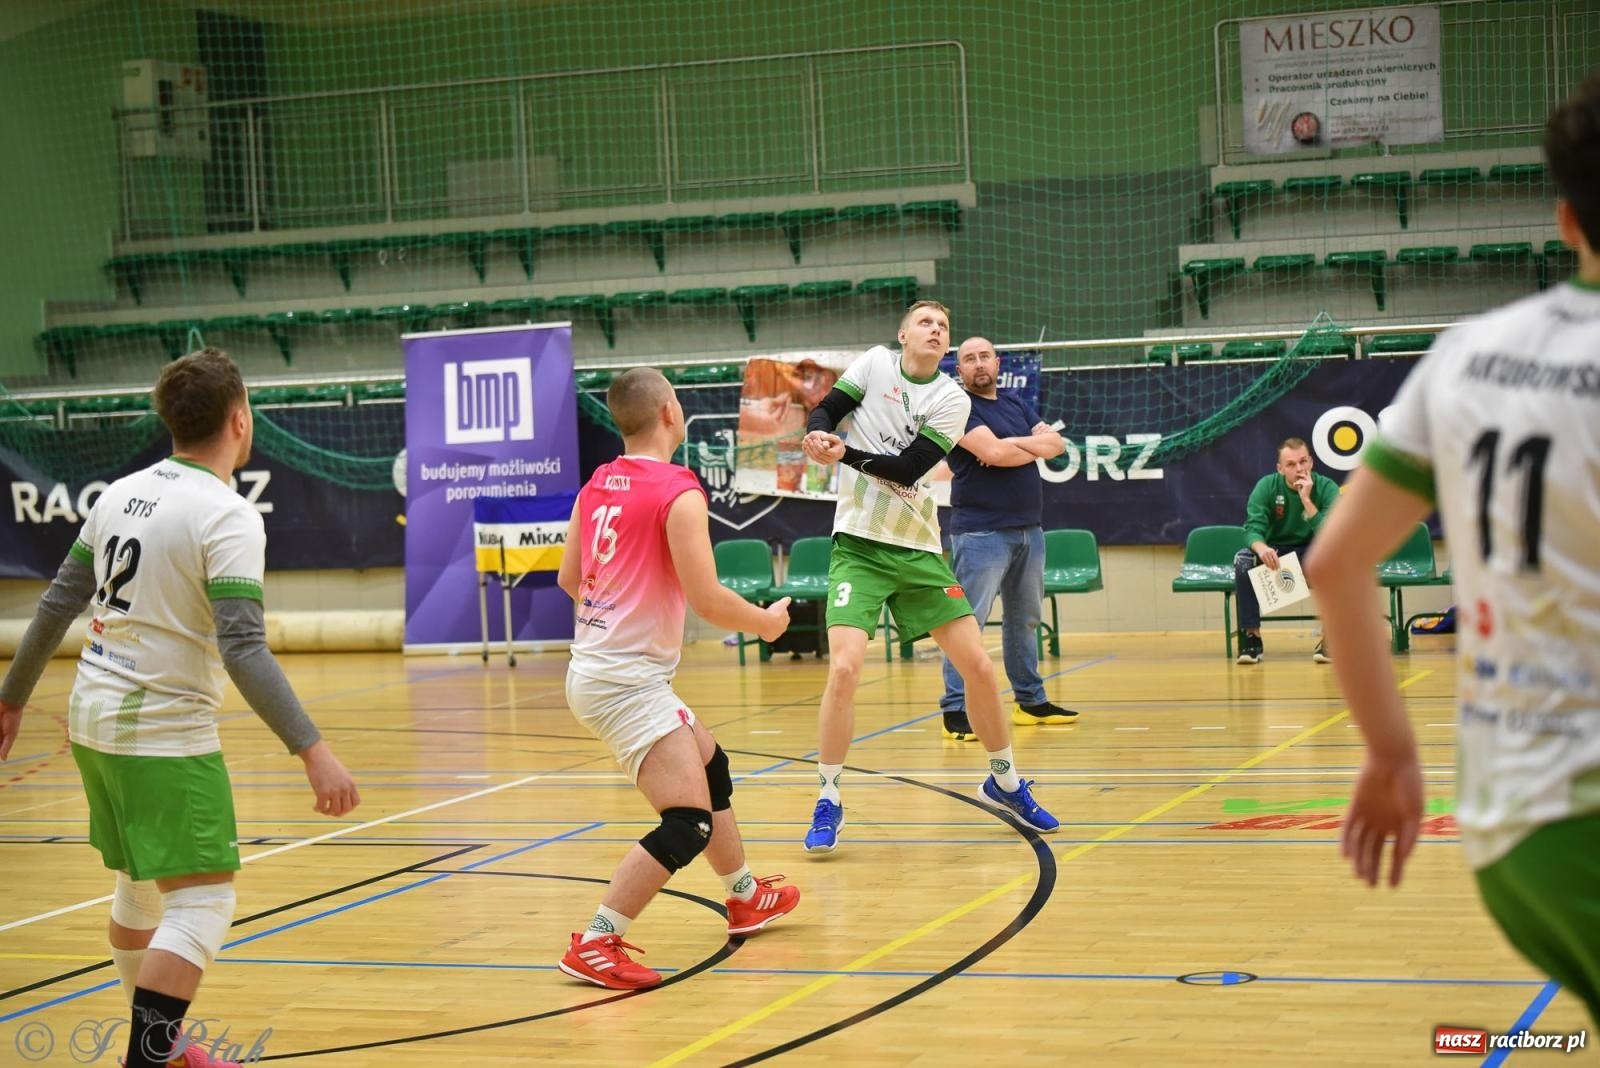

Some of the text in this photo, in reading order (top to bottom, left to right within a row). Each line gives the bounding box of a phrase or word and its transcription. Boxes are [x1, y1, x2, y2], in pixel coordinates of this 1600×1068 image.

[1263, 15, 1415, 53] MIESZKO
[1268, 72, 1313, 84] Operator
[1316, 67, 1363, 80] urządzeń
[1366, 61, 1437, 76] cukierniczych
[1268, 82, 1322, 94] Pracownik
[1330, 95, 1374, 106] Czekamy
[1378, 93, 1390, 101] na
[450, 359, 528, 443] bmp
[421, 457, 561, 482] budujemy możliwości
[446, 481, 537, 503] porozumienia
[1466, 429, 1552, 574] 11
[124, 497, 161, 517] STYŚ
[591, 505, 622, 565] 15
[96, 535, 142, 615] 12
[834, 582, 852, 607] 3
